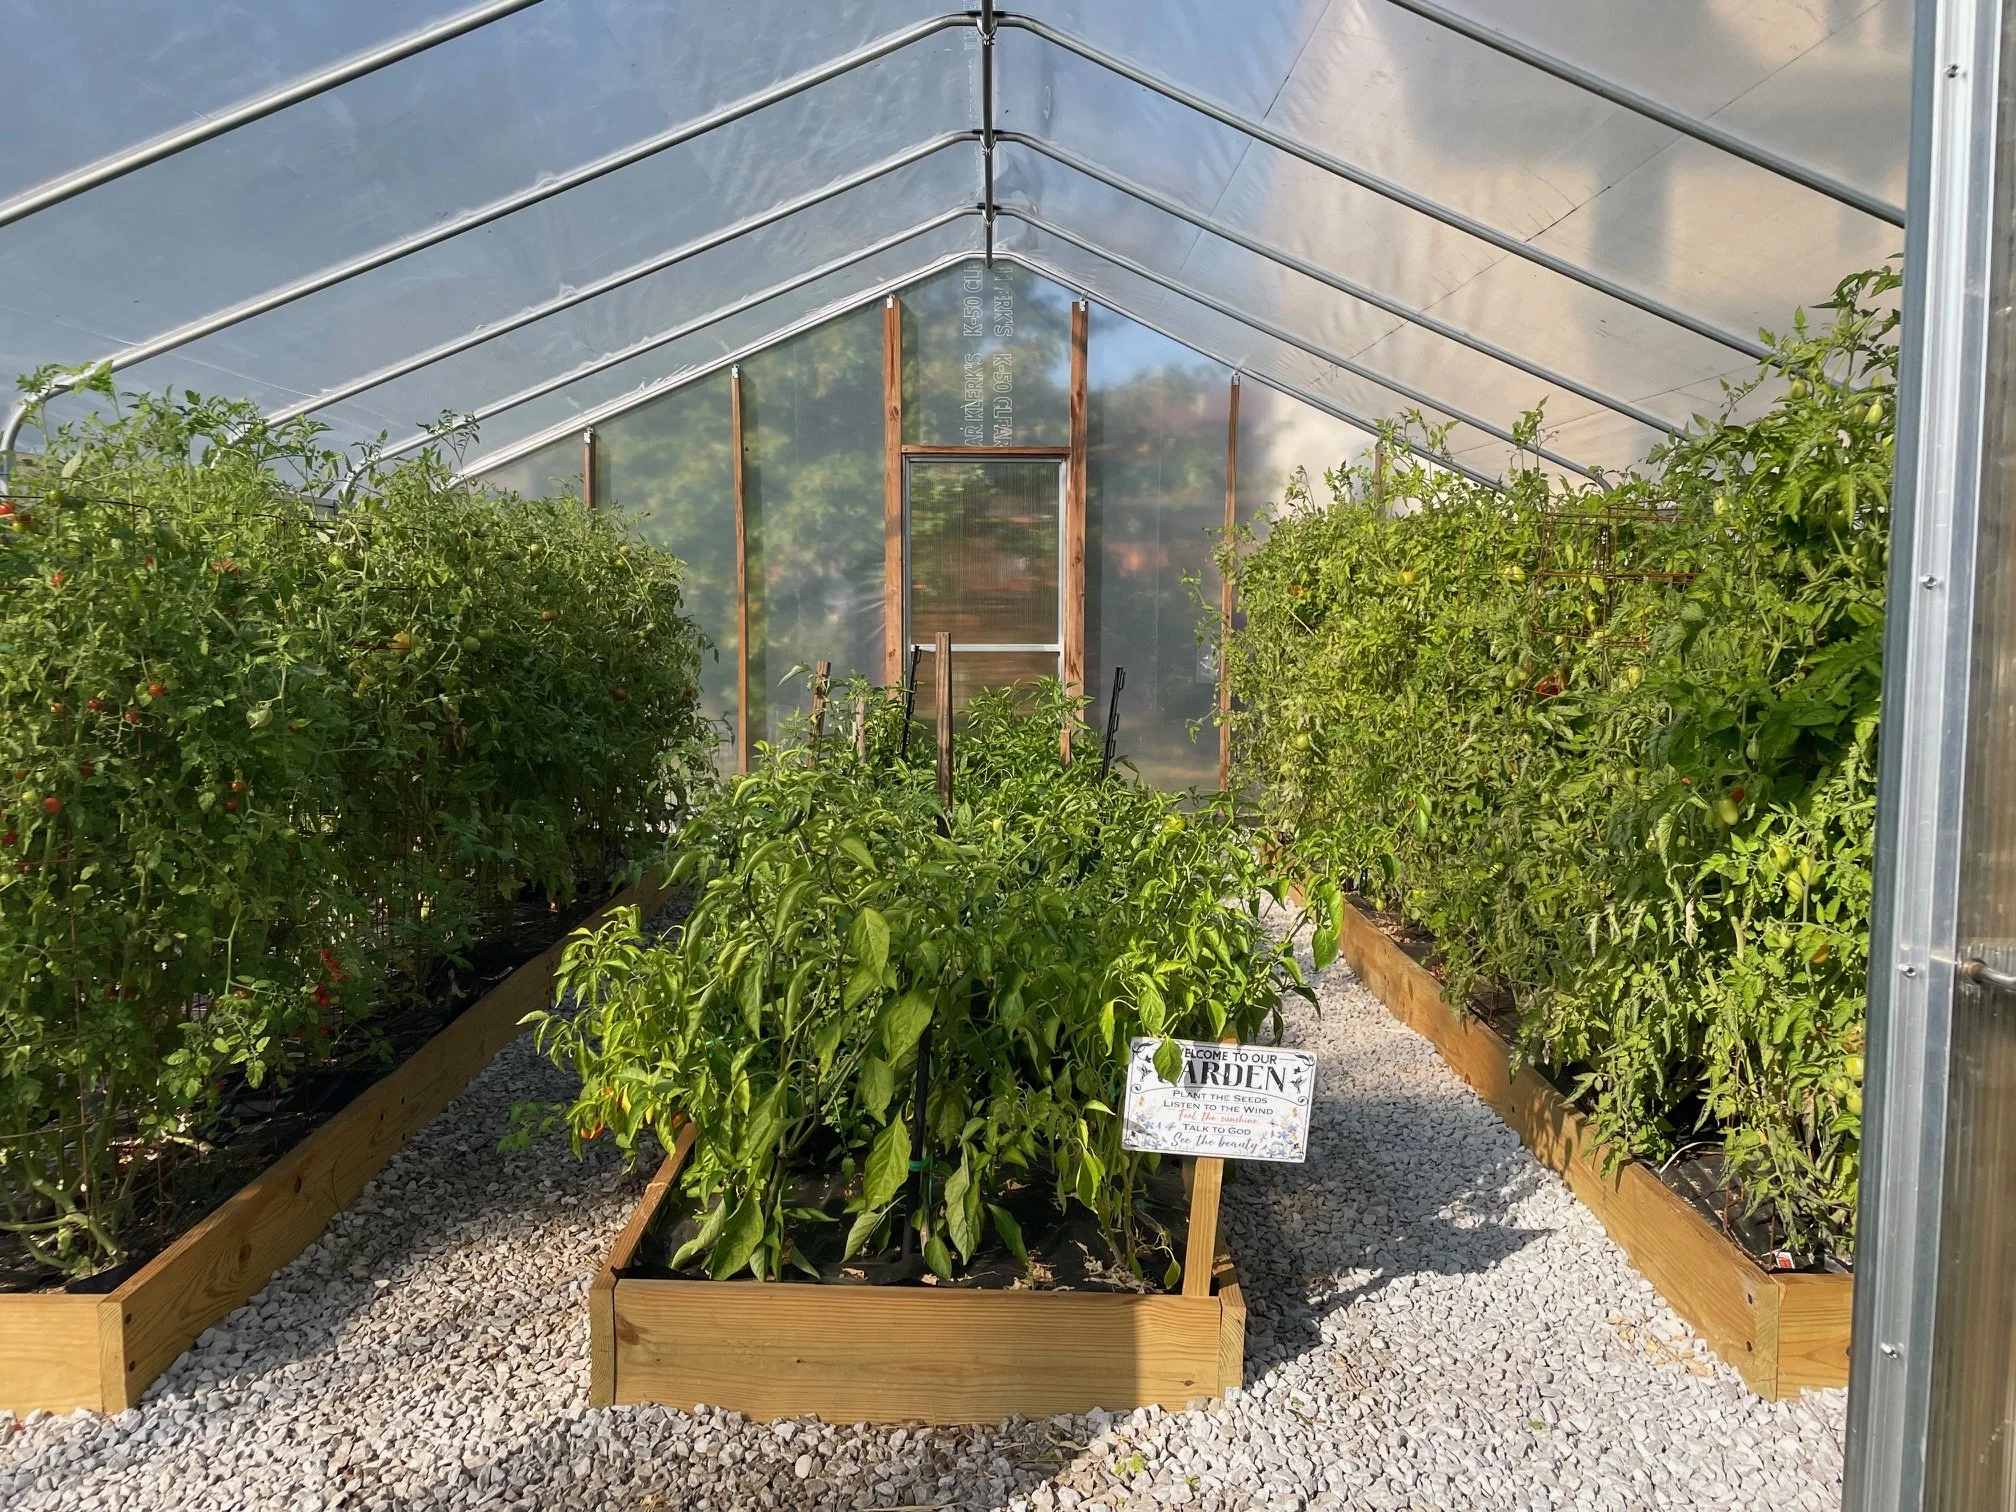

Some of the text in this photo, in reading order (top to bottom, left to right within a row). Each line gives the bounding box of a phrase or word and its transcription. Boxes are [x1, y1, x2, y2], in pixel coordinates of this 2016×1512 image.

[963, 296, 983, 337] K-50
[992, 353, 1013, 393] K-50
[1180, 1048, 1277, 1065] ELCOME TO OUR
[1158, 1060, 1287, 1093] ARDEN
[1201, 1111, 1216, 1122] the
[1221, 1114, 1257, 1125] sunshine
[1171, 1131, 1259, 1154] See the beauty
